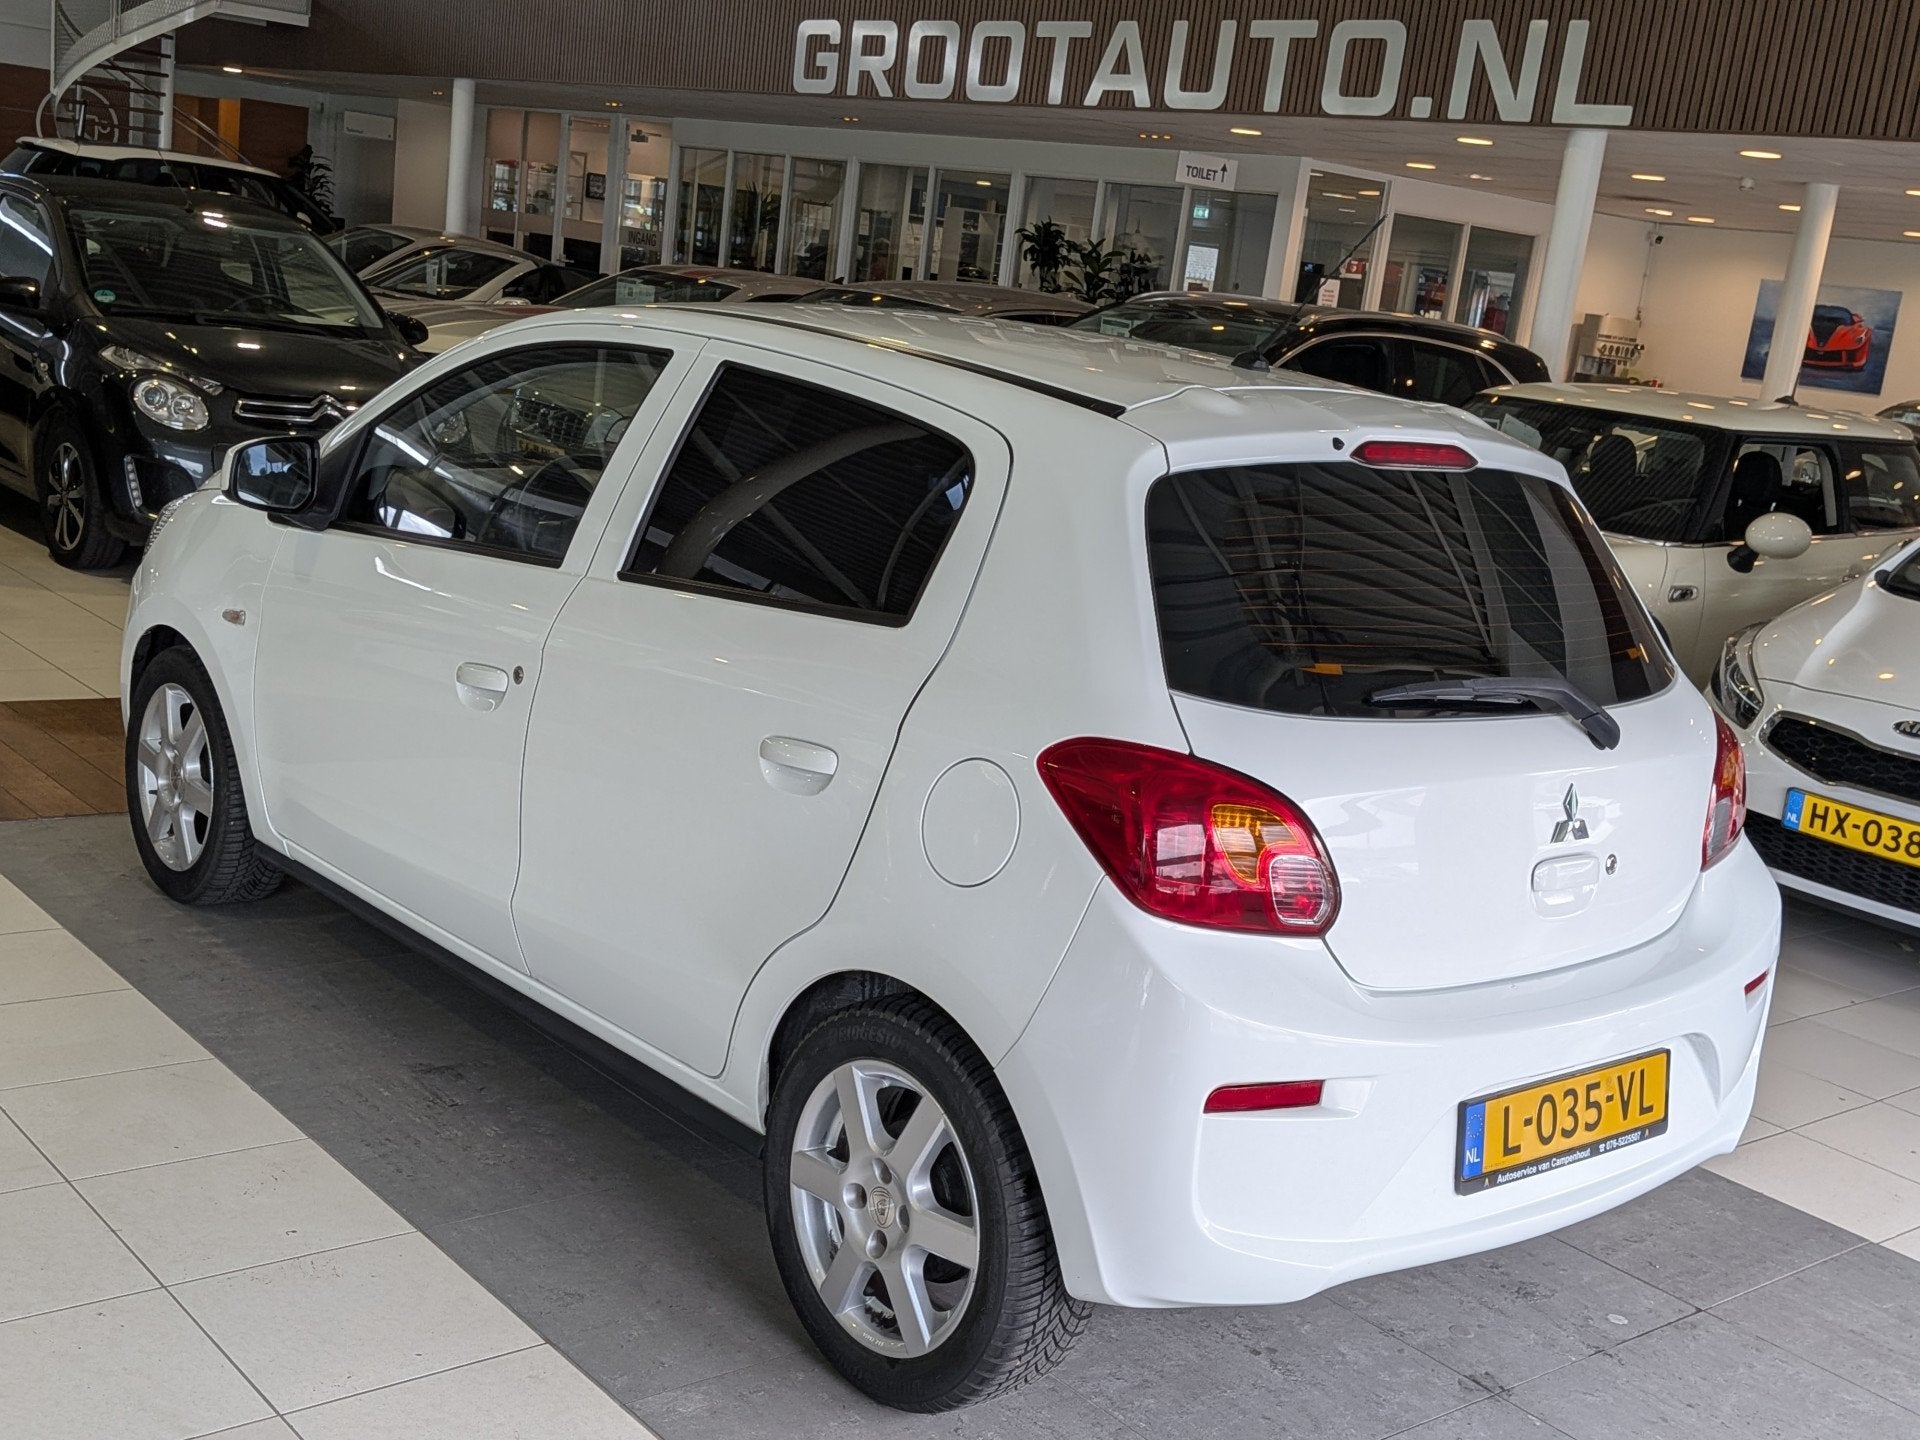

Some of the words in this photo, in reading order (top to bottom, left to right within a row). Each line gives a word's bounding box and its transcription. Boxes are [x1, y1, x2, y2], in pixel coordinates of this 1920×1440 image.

[793, 19, 1634, 126] GROOTAUTO.NL
[1186, 165, 1218, 181] TOILET
[628, 231, 657, 246] INGANG
[1786, 812, 1799, 823] NL
[1809, 803, 1920, 858] HX-038
[1503, 1068, 1654, 1157] L-035-VL
[1465, 1147, 1481, 1165] NL
[1496, 1165, 1537, 1184] Autoservice
[1538, 1161, 1550, 1172] van
[1551, 1148, 1591, 1168] Campenhout
